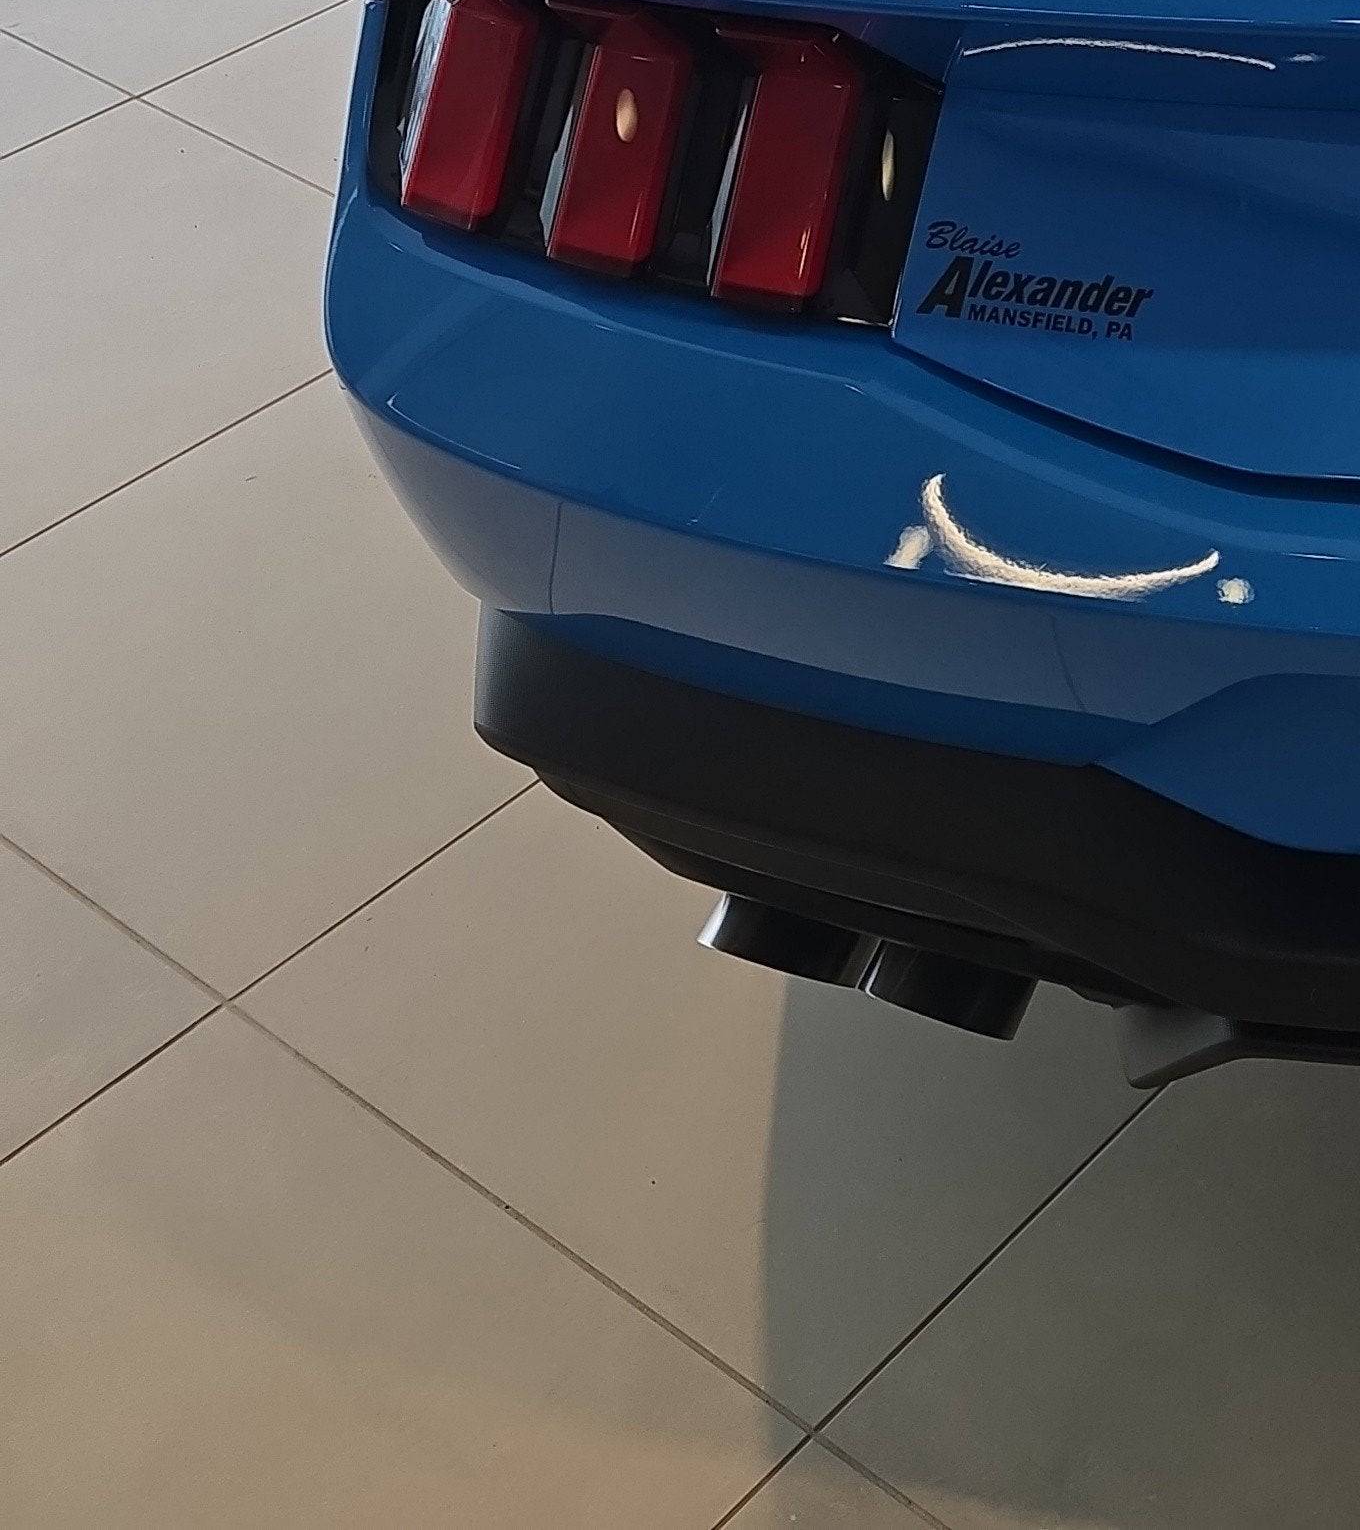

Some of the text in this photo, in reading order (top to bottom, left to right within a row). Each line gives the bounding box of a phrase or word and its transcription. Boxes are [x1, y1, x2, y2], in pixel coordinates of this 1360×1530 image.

[925, 220, 1022, 259] Blaise
[915, 255, 1155, 319] Alexander
[967, 303, 1134, 341] MANSFIELD, PA
